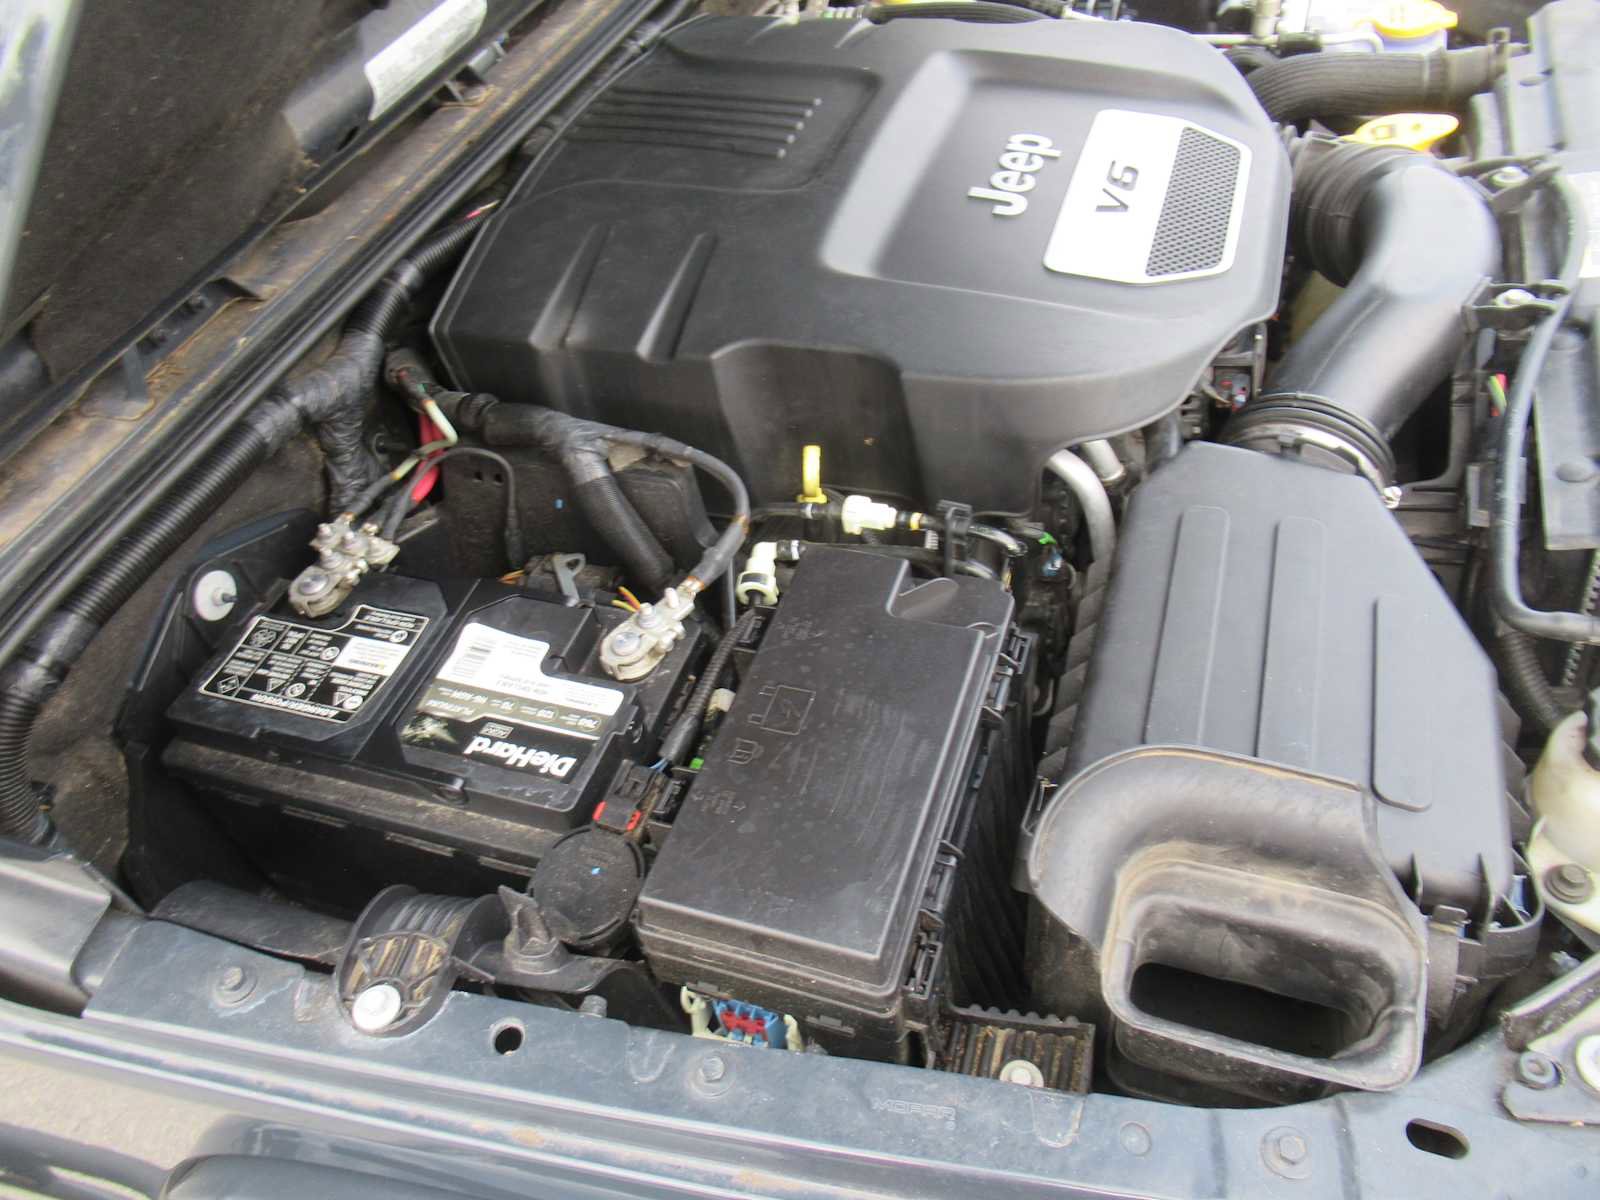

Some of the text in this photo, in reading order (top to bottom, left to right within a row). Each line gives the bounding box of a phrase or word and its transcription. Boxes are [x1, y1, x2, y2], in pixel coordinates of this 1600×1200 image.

[967, 133, 1062, 217] Jeep
[1095, 160, 1139, 213] V6
[463, 735, 577, 777] DieHard
